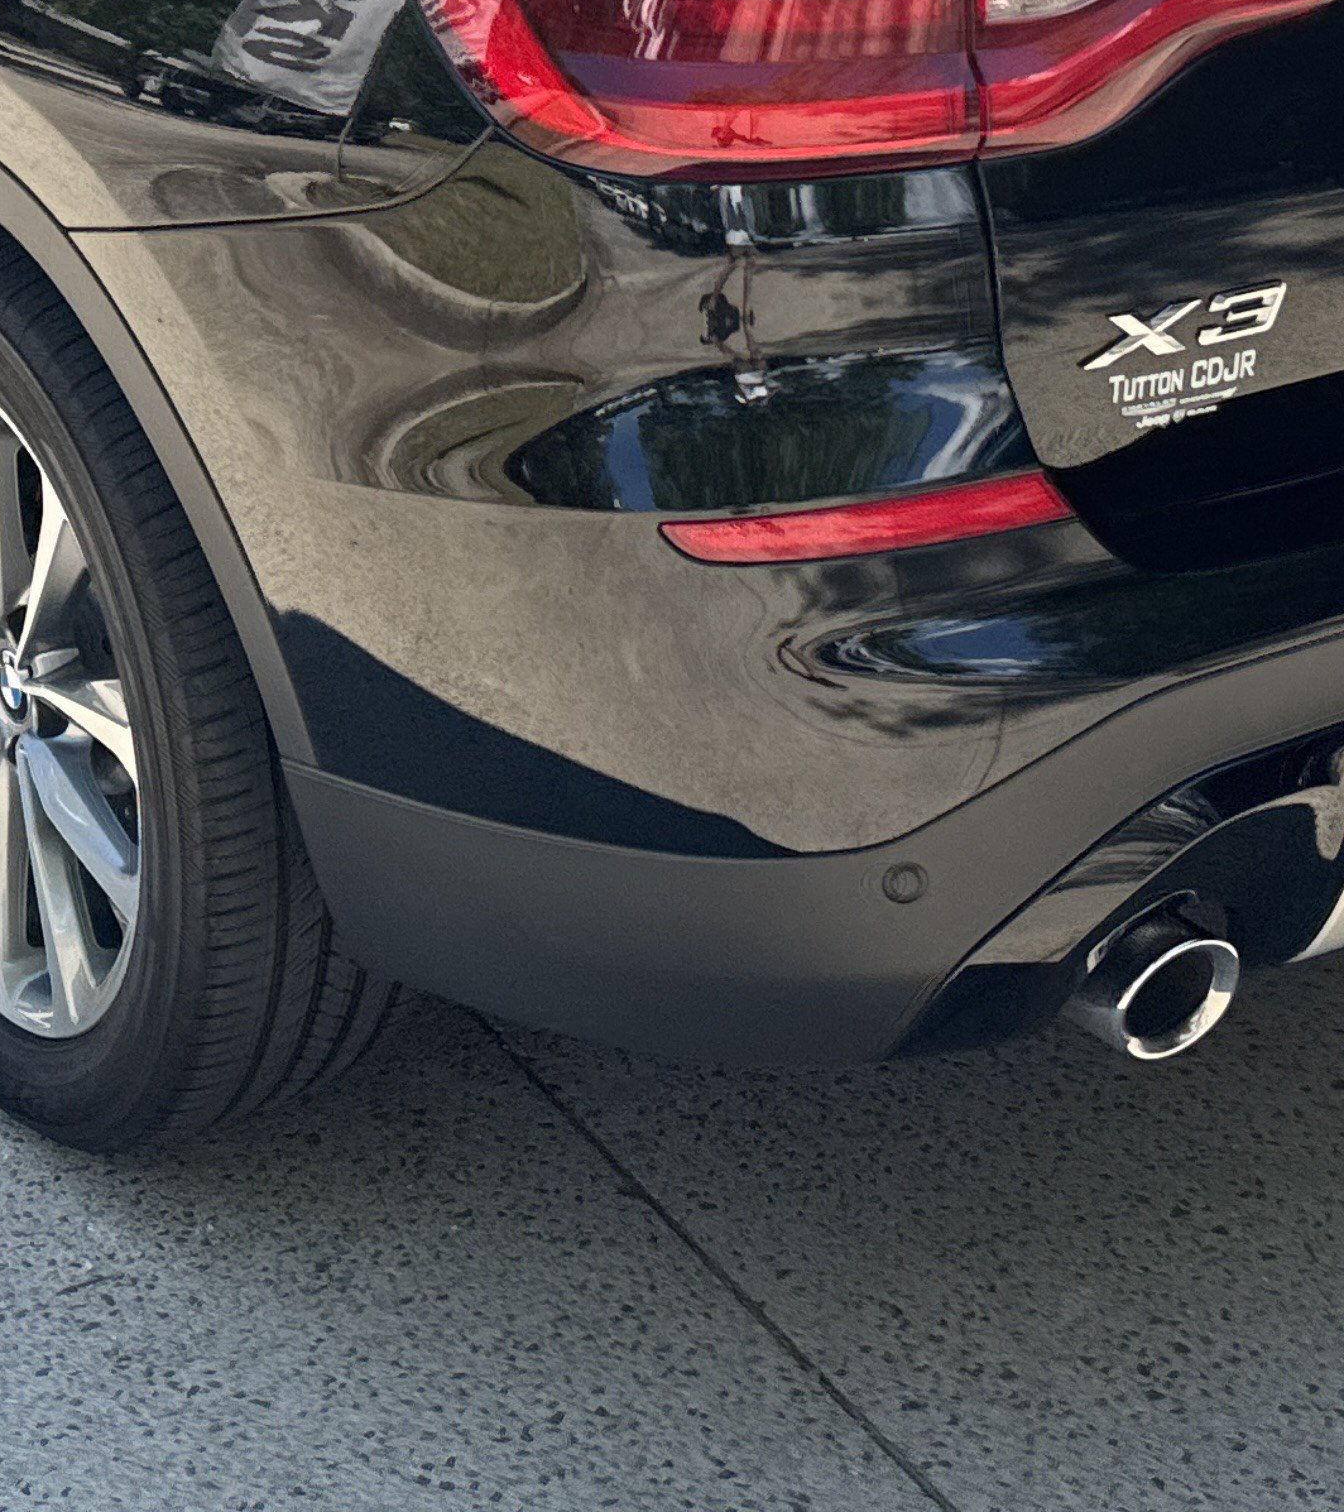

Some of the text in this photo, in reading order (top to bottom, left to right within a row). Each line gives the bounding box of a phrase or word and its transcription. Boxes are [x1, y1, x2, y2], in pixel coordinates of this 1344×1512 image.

[1083, 283, 1287, 371] X3
[1108, 369, 1185, 404] TUTTON
[1190, 349, 1257, 388] CDJR
